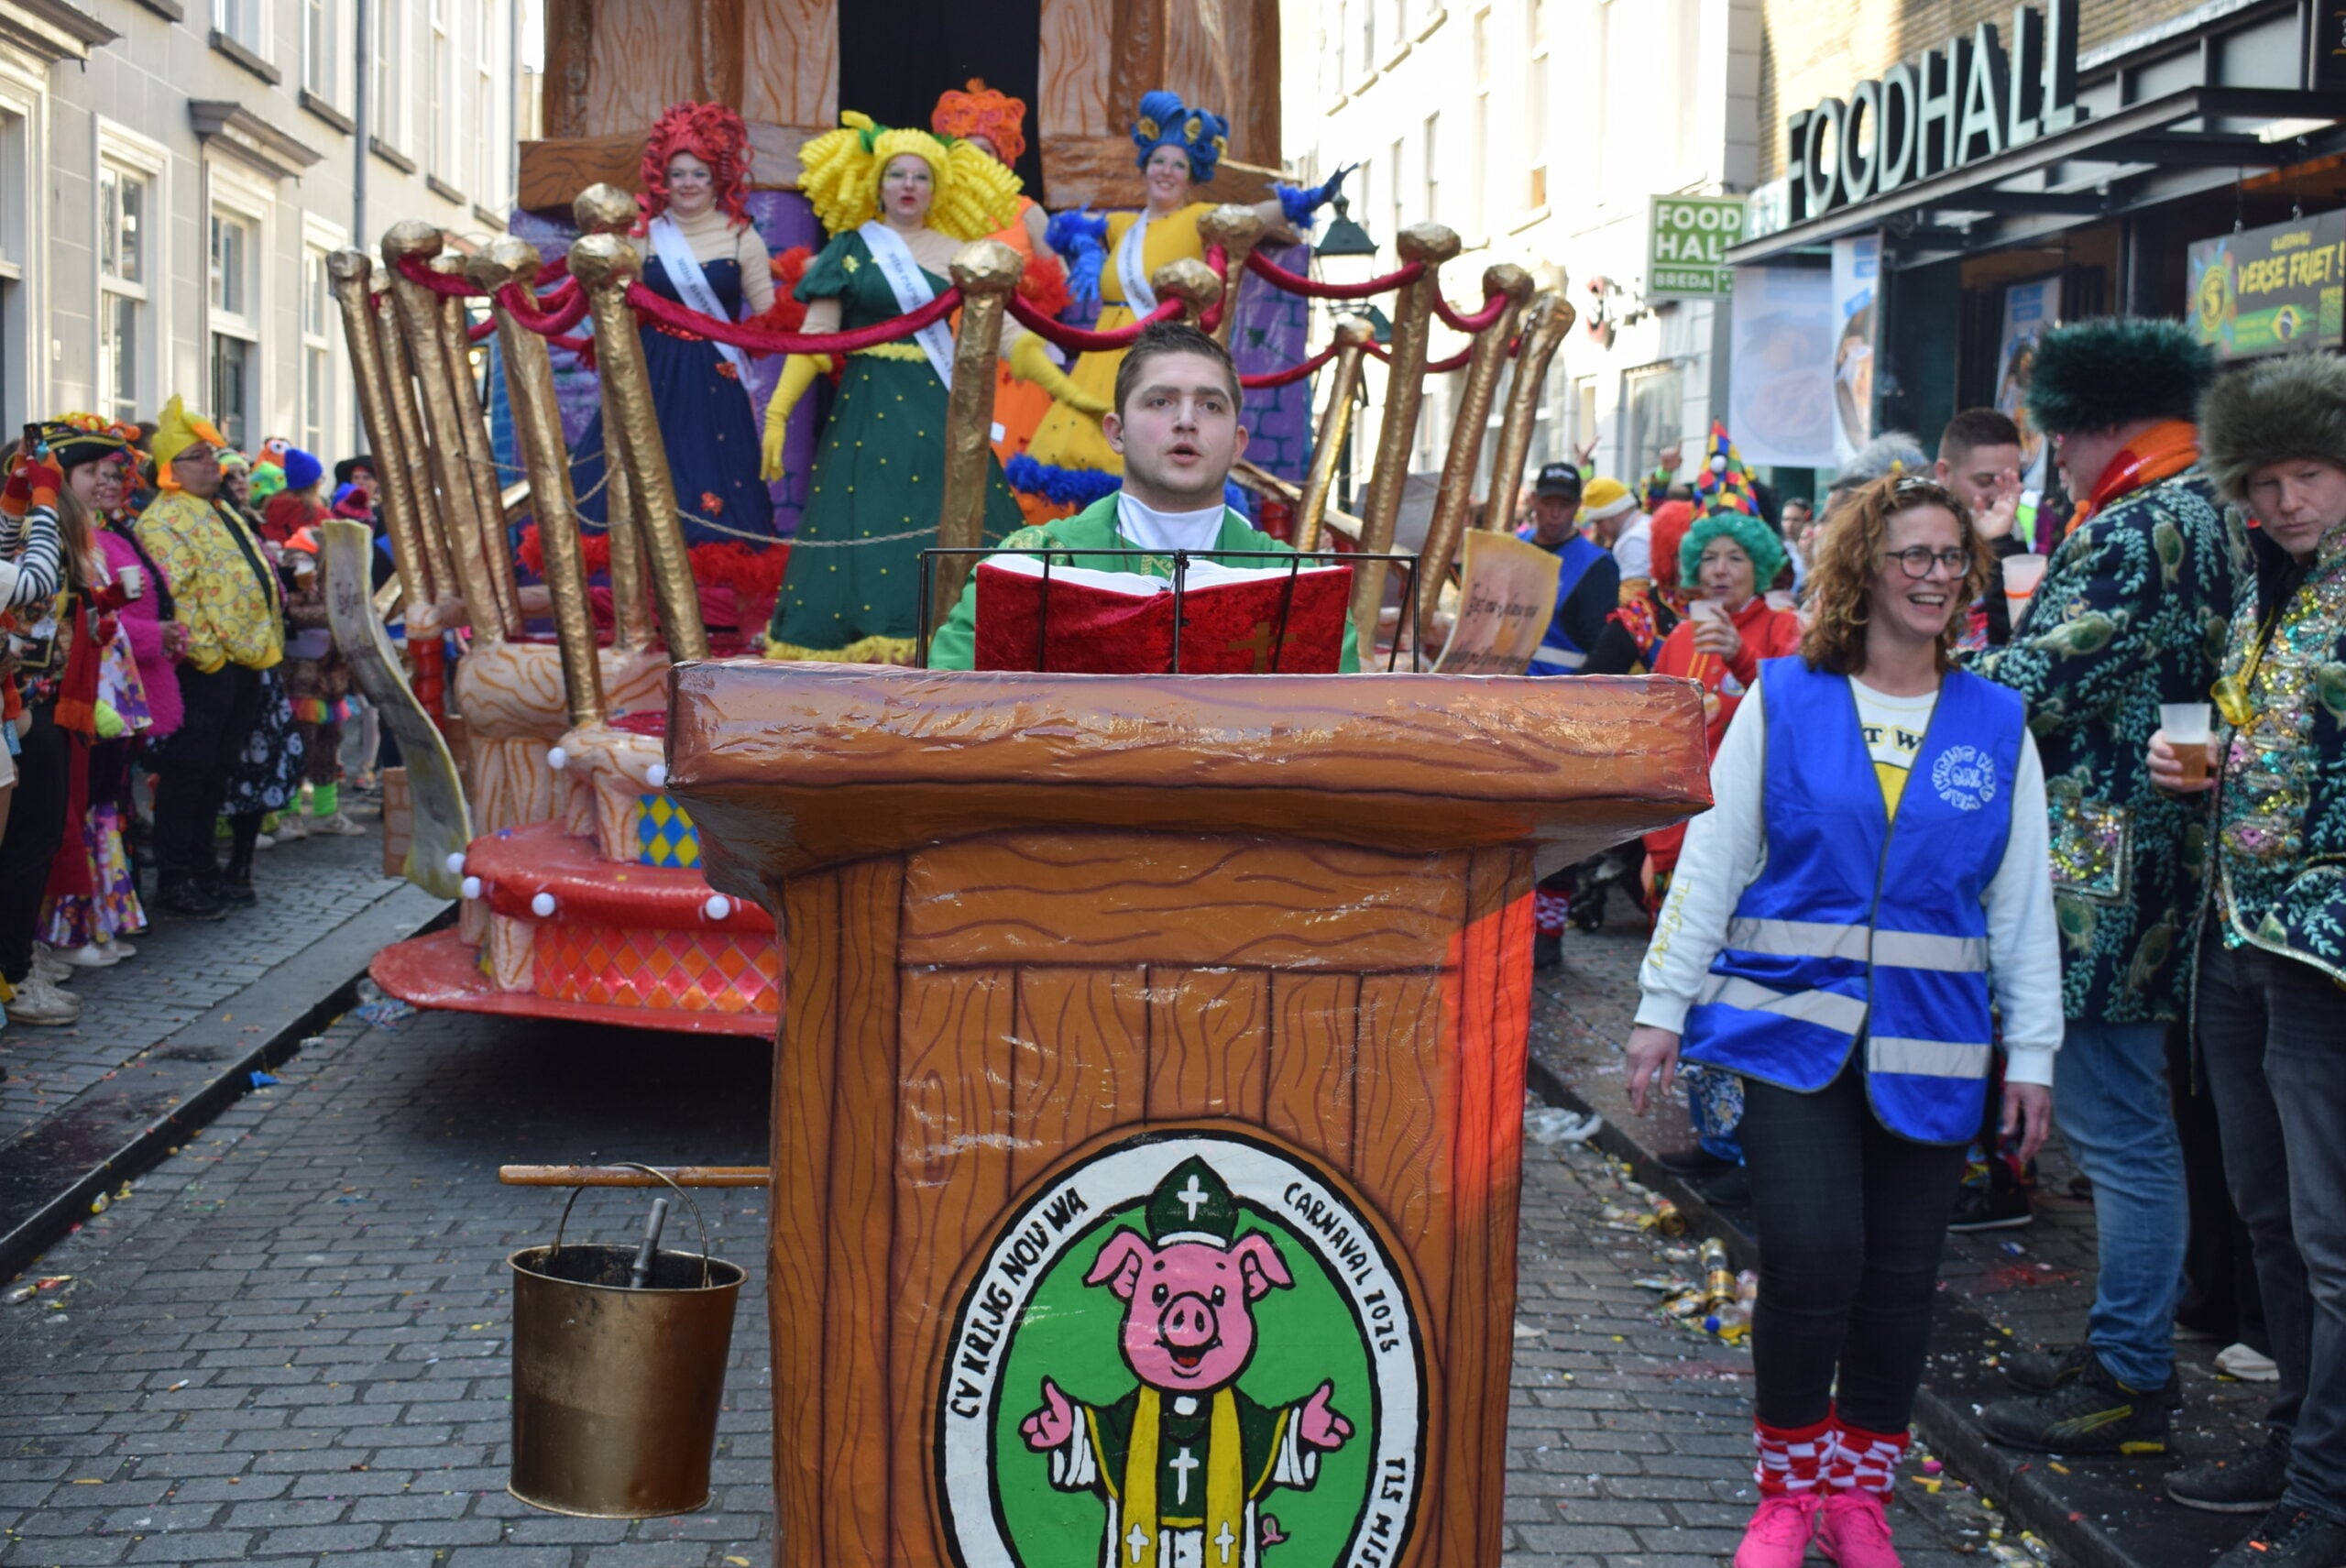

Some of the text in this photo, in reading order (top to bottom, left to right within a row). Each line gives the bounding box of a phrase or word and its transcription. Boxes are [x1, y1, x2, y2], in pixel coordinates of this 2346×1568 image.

[1787, 0, 2078, 229] FOODHALL
[1656, 204, 1741, 231] FOOD
[1655, 271, 1712, 289] BREDA
[2237, 256, 2287, 294] VERSE
[1284, 1182, 1373, 1286] CARNAVAL
[950, 1187, 1089, 1419] CV KRIJG NOU WA
[1354, 1512, 1392, 1568] MIS
